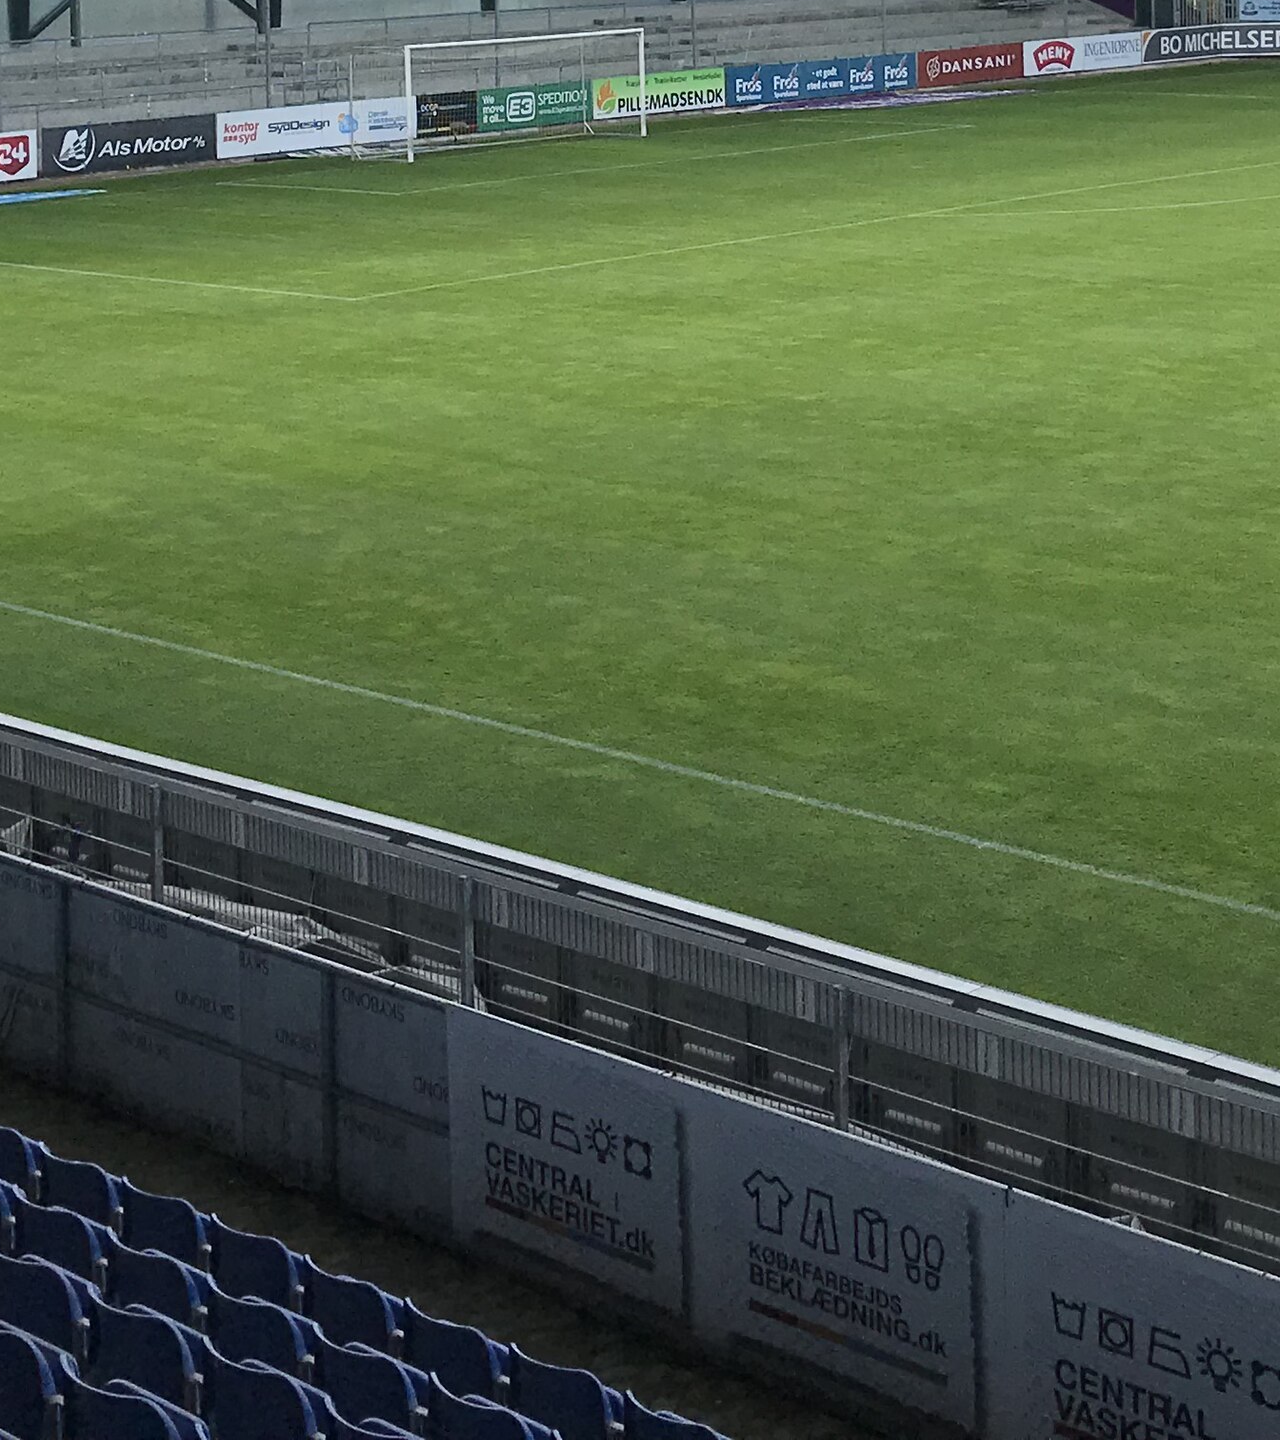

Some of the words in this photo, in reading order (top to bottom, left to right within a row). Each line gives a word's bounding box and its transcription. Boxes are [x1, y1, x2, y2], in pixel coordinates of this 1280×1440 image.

[1036, 45, 1073, 66] MENY
[1160, 36, 1181, 56] BO
[942, 54, 1013, 74] DANSANI
[508, 97, 534, 116] E3
[223, 121, 260, 134] kontor
[97, 140, 132, 158] Als
[133, 136, 192, 155] Motor
[238, 132, 258, 145] syd
[341, 986, 405, 1023] SKYBOND
[485, 1141, 600, 1209] CENTRAL
[486, 1169, 656, 1261] VASKERIET.dk
[748, 1261, 948, 1359] BEKLÆDNING.dk
[1054, 1359, 1217, 1440] CENTRAL
